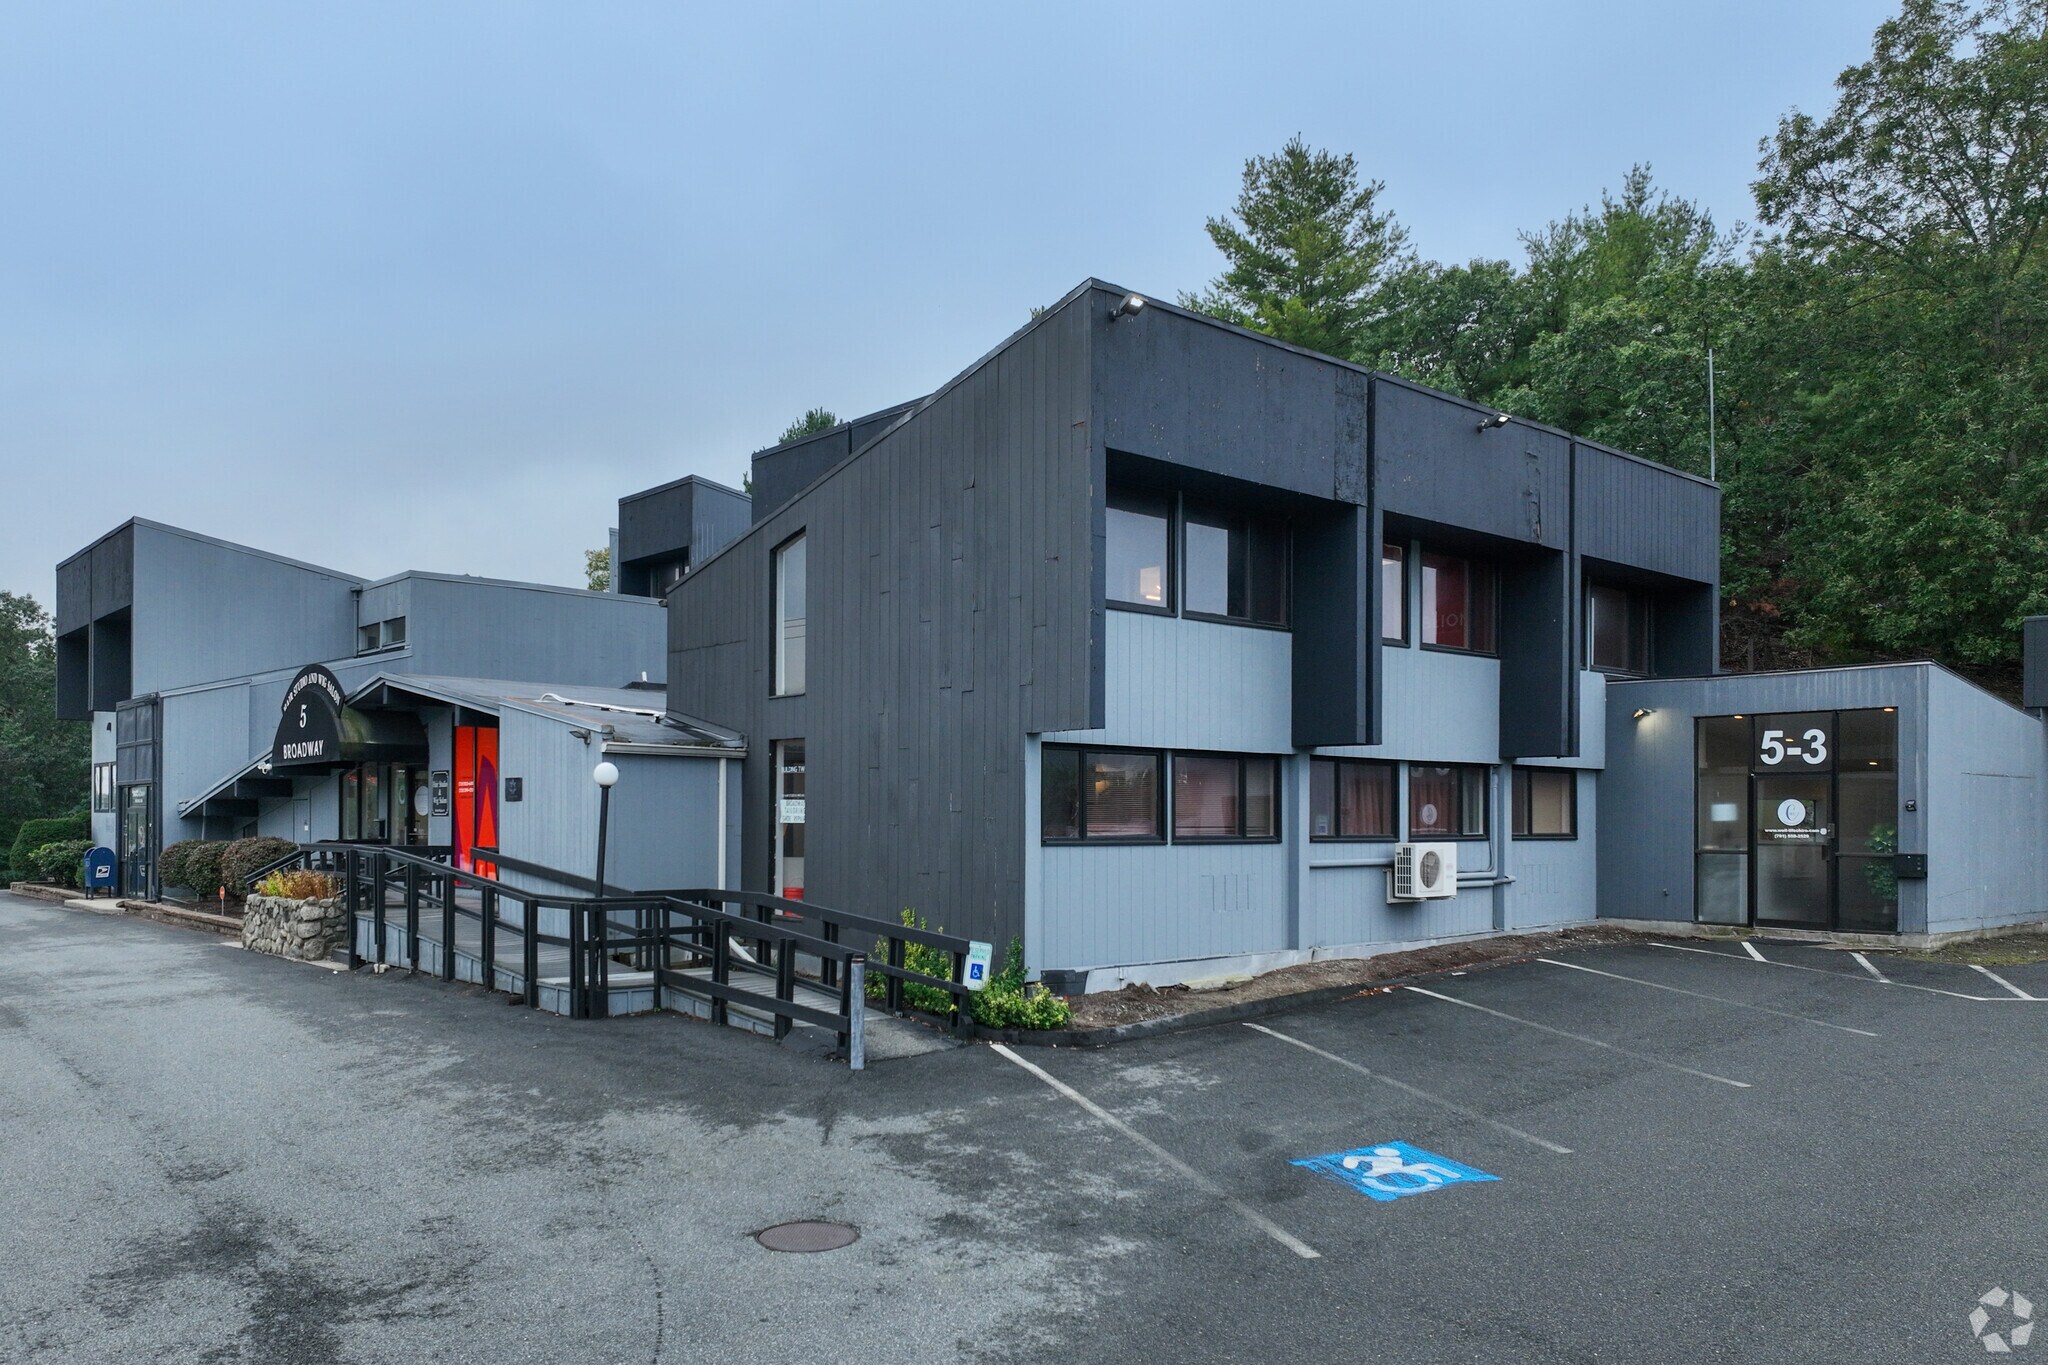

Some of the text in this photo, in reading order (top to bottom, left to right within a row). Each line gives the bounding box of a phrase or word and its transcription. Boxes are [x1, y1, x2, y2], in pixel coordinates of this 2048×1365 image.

[293, 675, 308, 697] STUDIO
[308, 672, 318, 685] AND
[318, 673, 328, 688] WIG
[299, 704, 308, 728] 5
[283, 739, 324, 759] BROADWAY
[1760, 728, 1827, 765] 5-3
